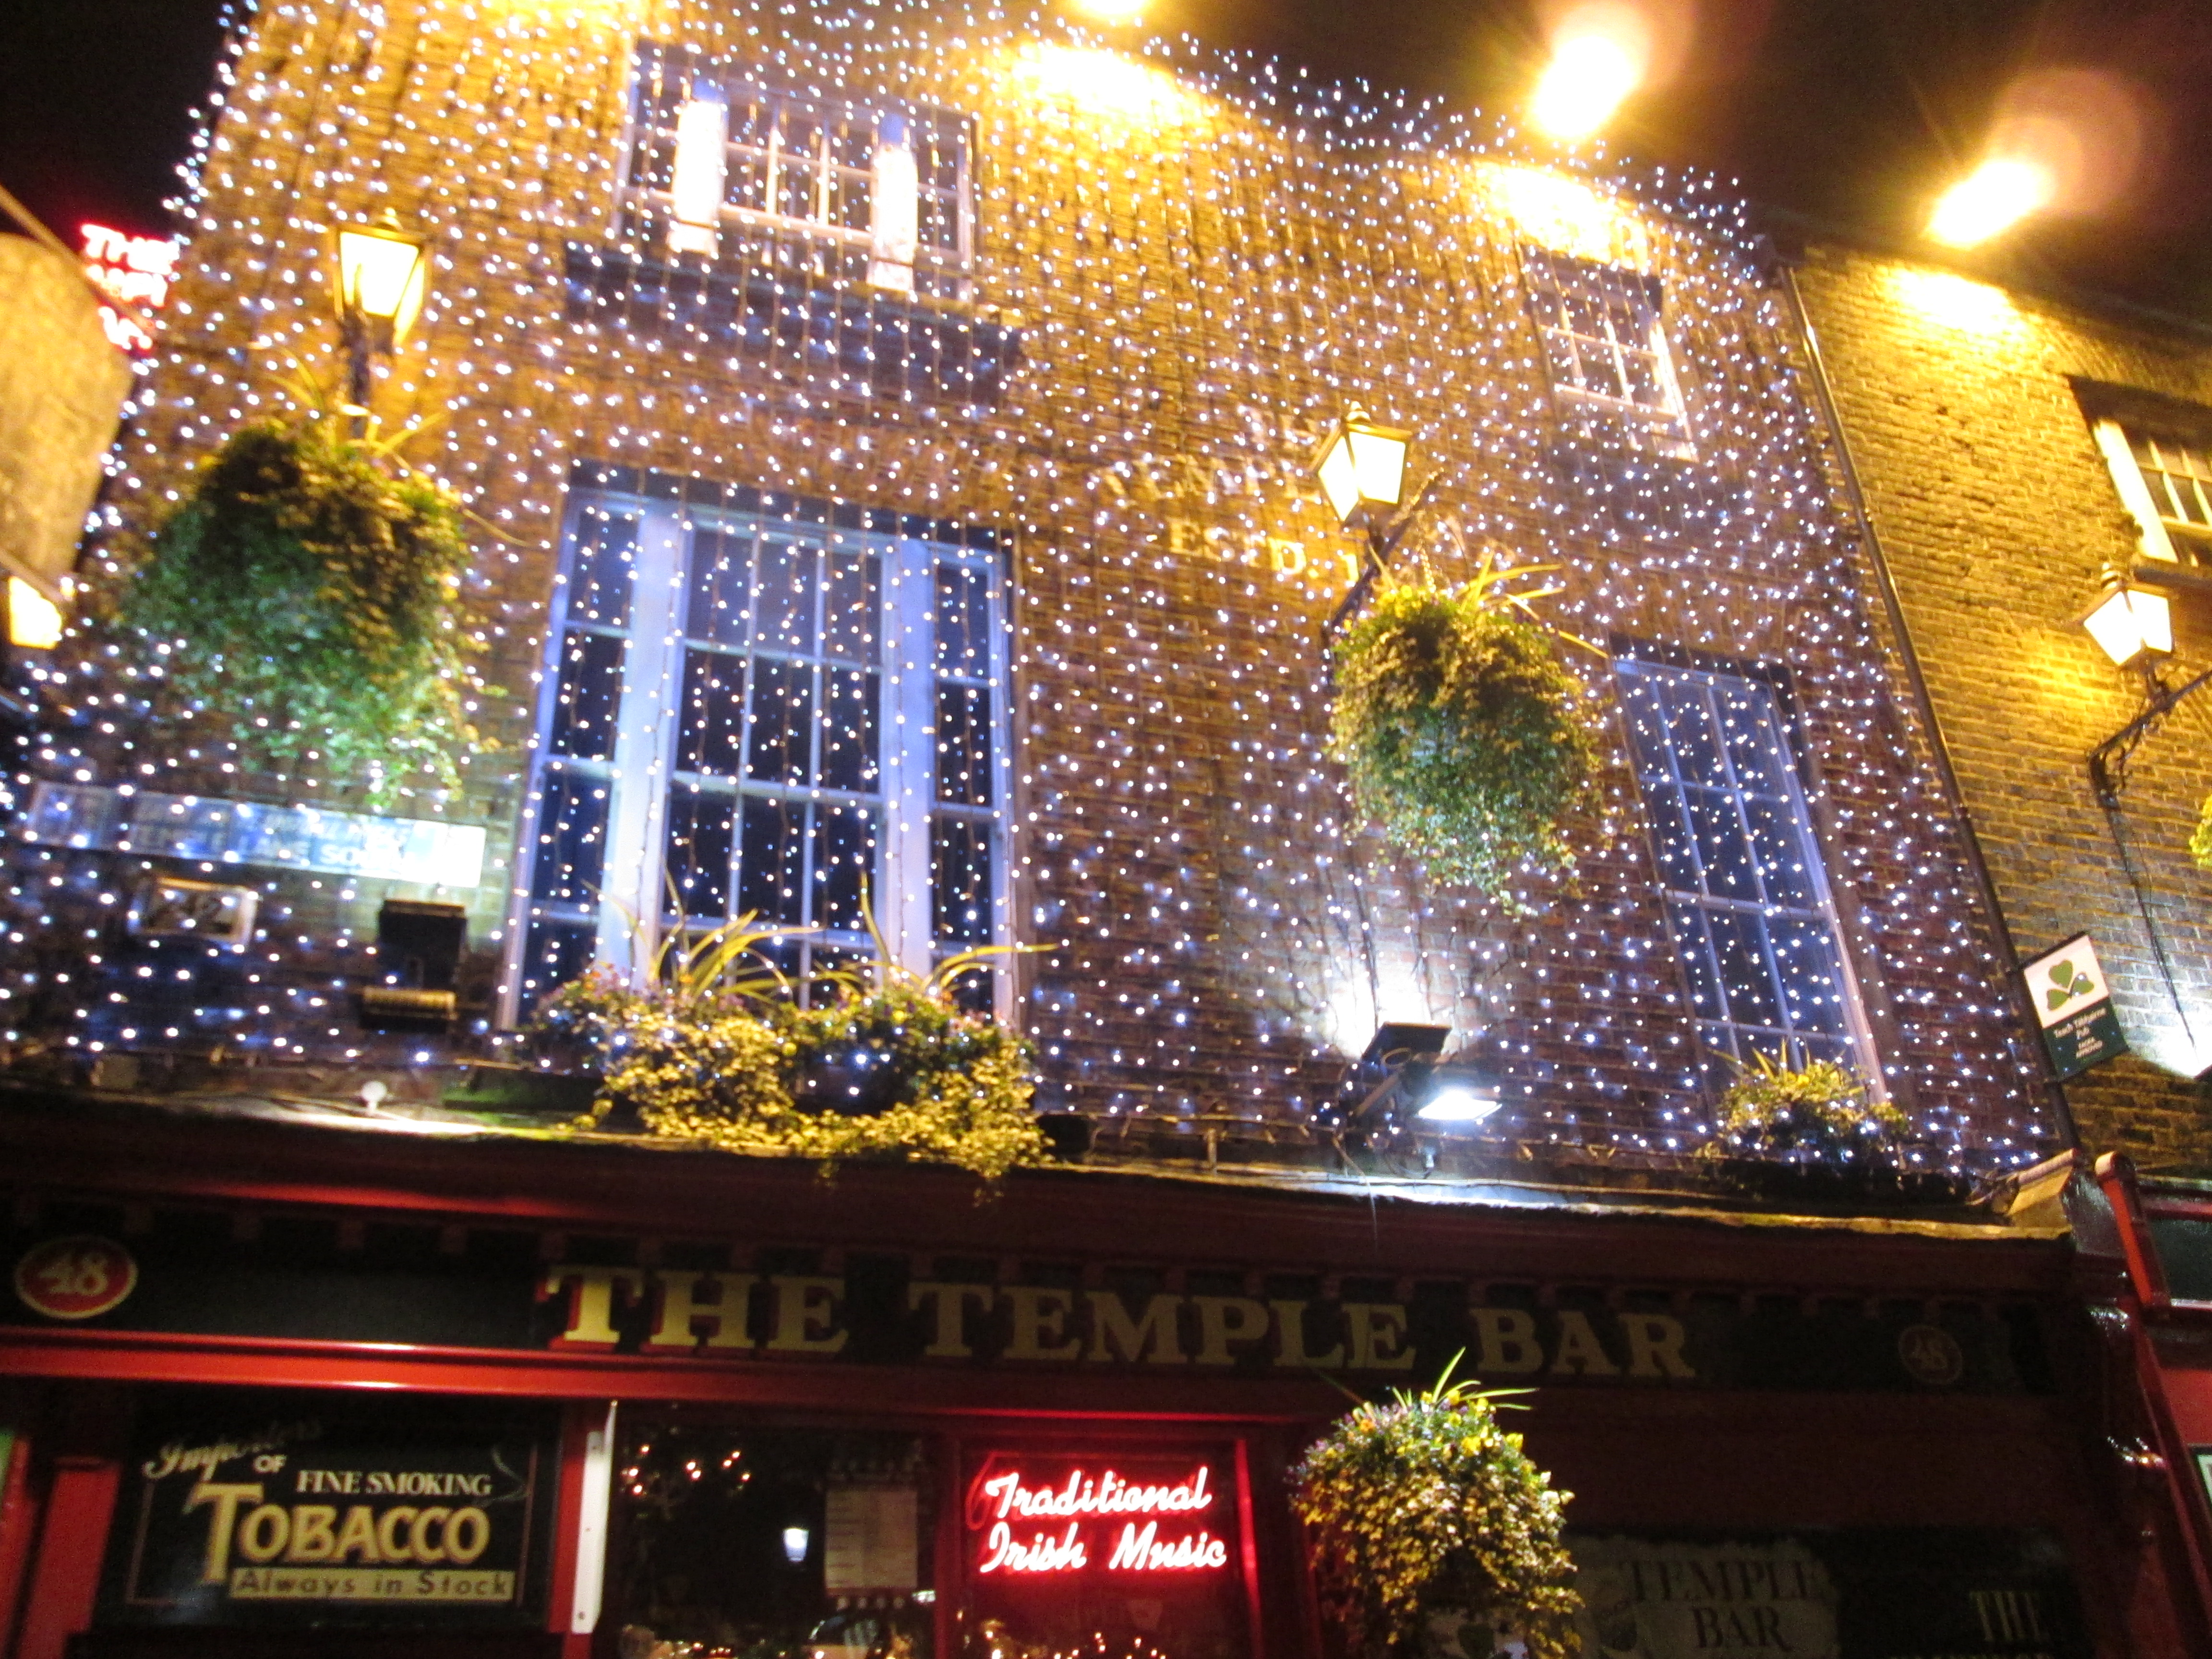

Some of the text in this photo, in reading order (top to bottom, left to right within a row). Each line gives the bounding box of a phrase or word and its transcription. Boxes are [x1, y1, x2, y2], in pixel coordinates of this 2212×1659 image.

[37, 1250, 108, 1295] 48
[545, 1265, 1696, 1379] THE TEMPLE BAR
[253, 1455, 287, 1474] OF
[296, 1469, 493, 1496] FINE SMOKING
[984, 1466, 1213, 1519] Traditional
[182, 1482, 492, 1585] TOBACCO
[979, 1520, 1227, 1573] Irish Music
[240, 1569, 509, 1598] Always in Stock
[1619, 1558, 1824, 1652] TEMPLE BAR
